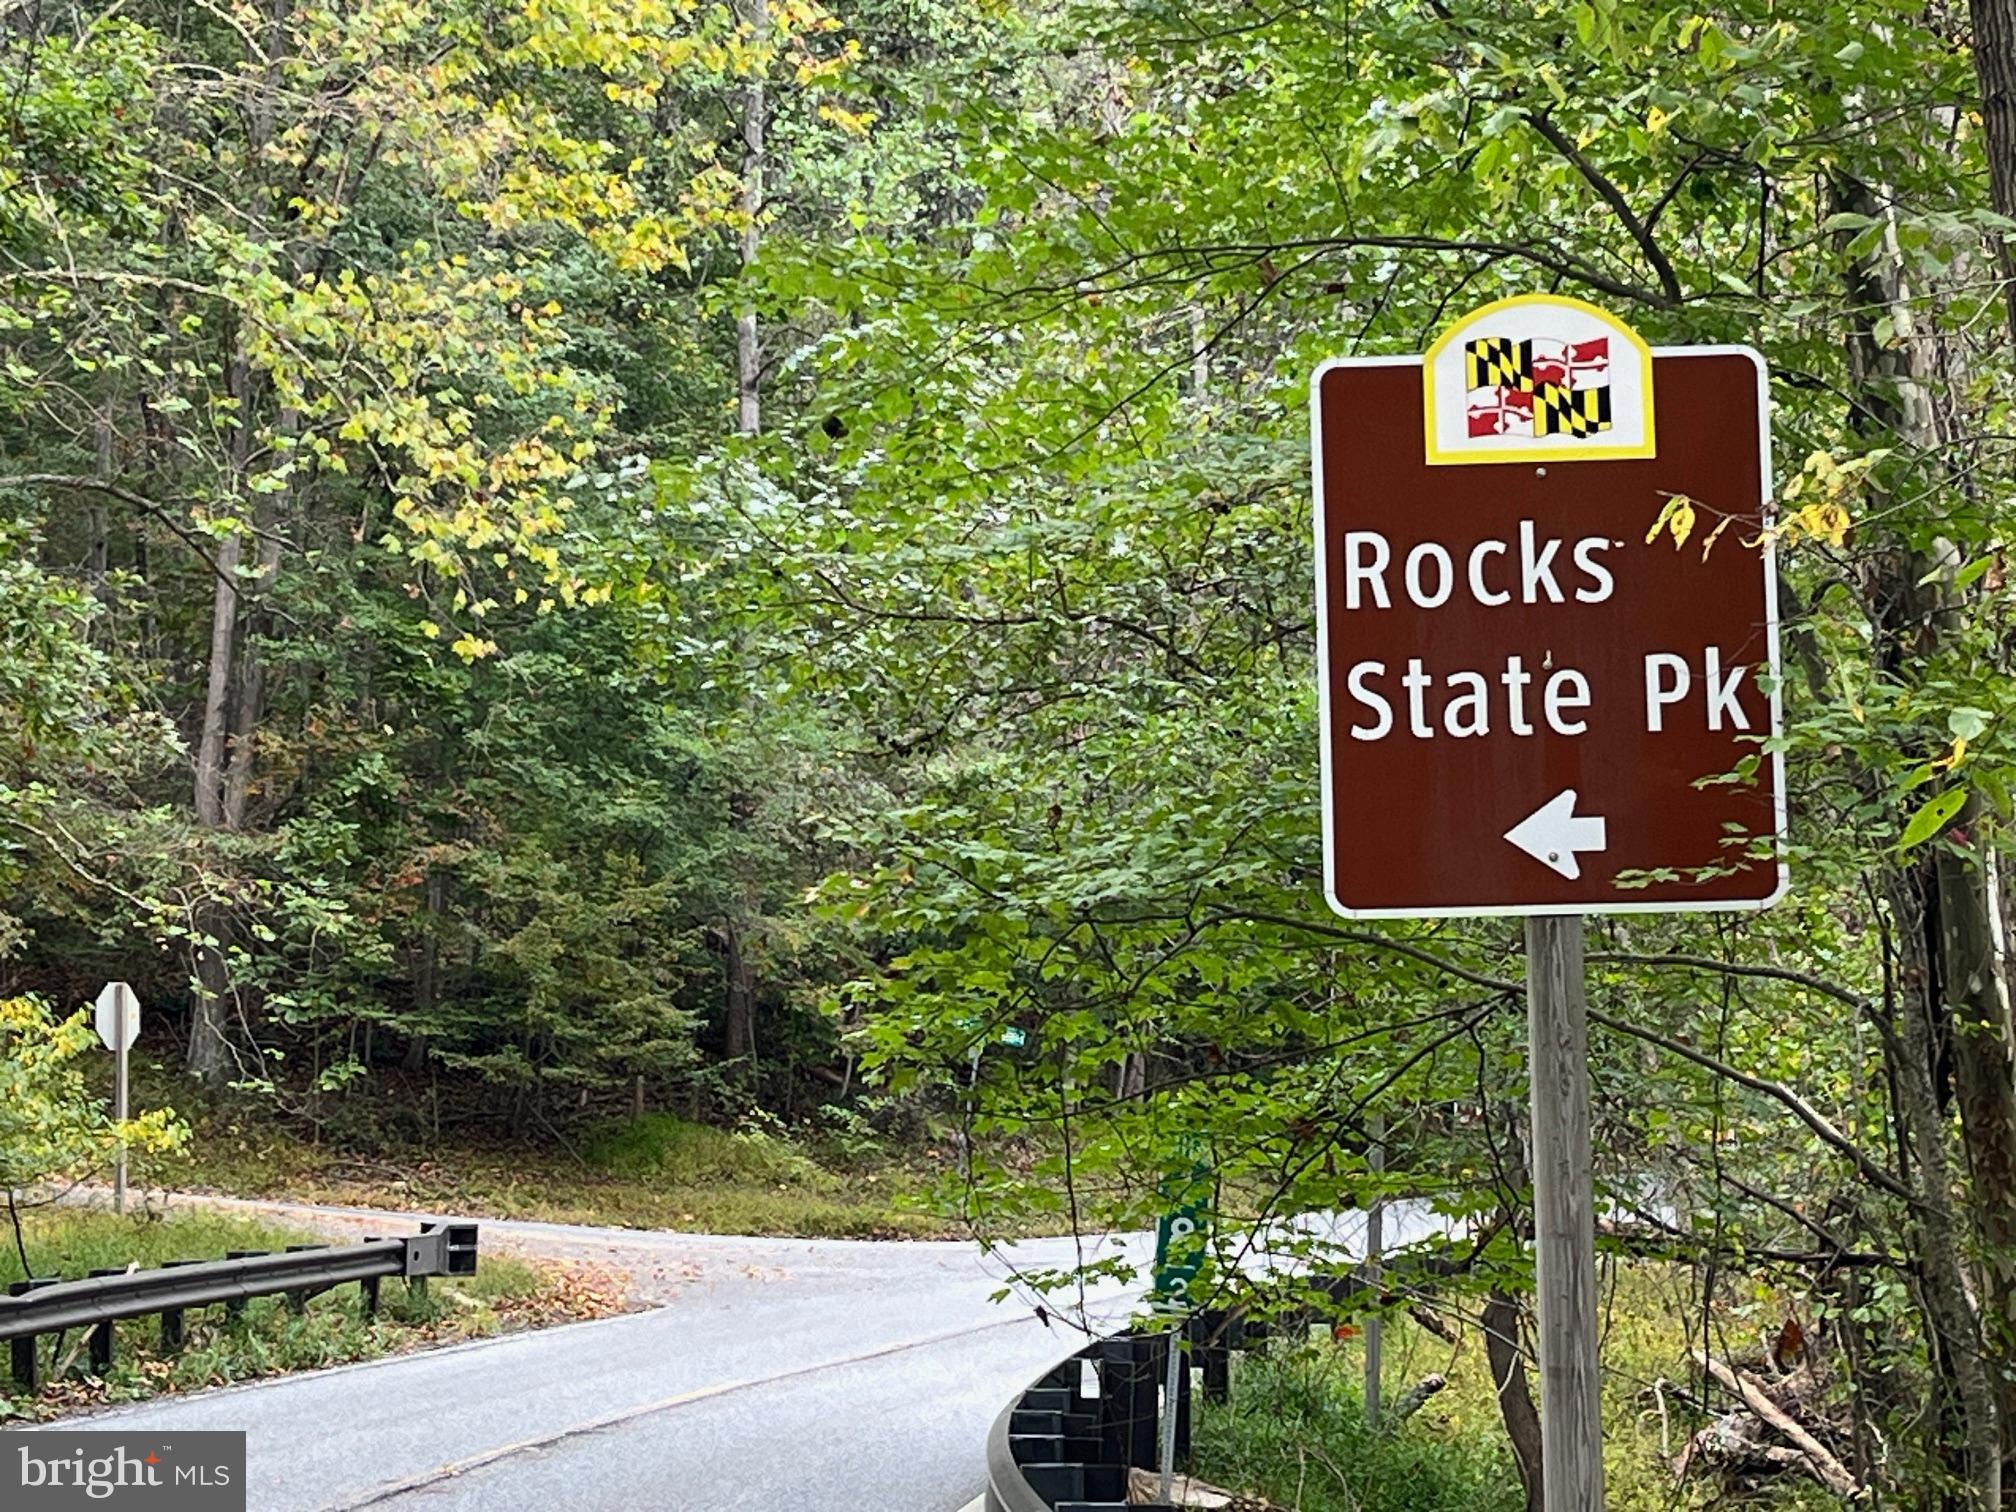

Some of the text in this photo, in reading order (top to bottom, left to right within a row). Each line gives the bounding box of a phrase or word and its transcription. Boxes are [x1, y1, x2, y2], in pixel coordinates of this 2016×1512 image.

[1345, 520, 1614, 609] Rocks
[1347, 646, 1751, 741] State Pk
